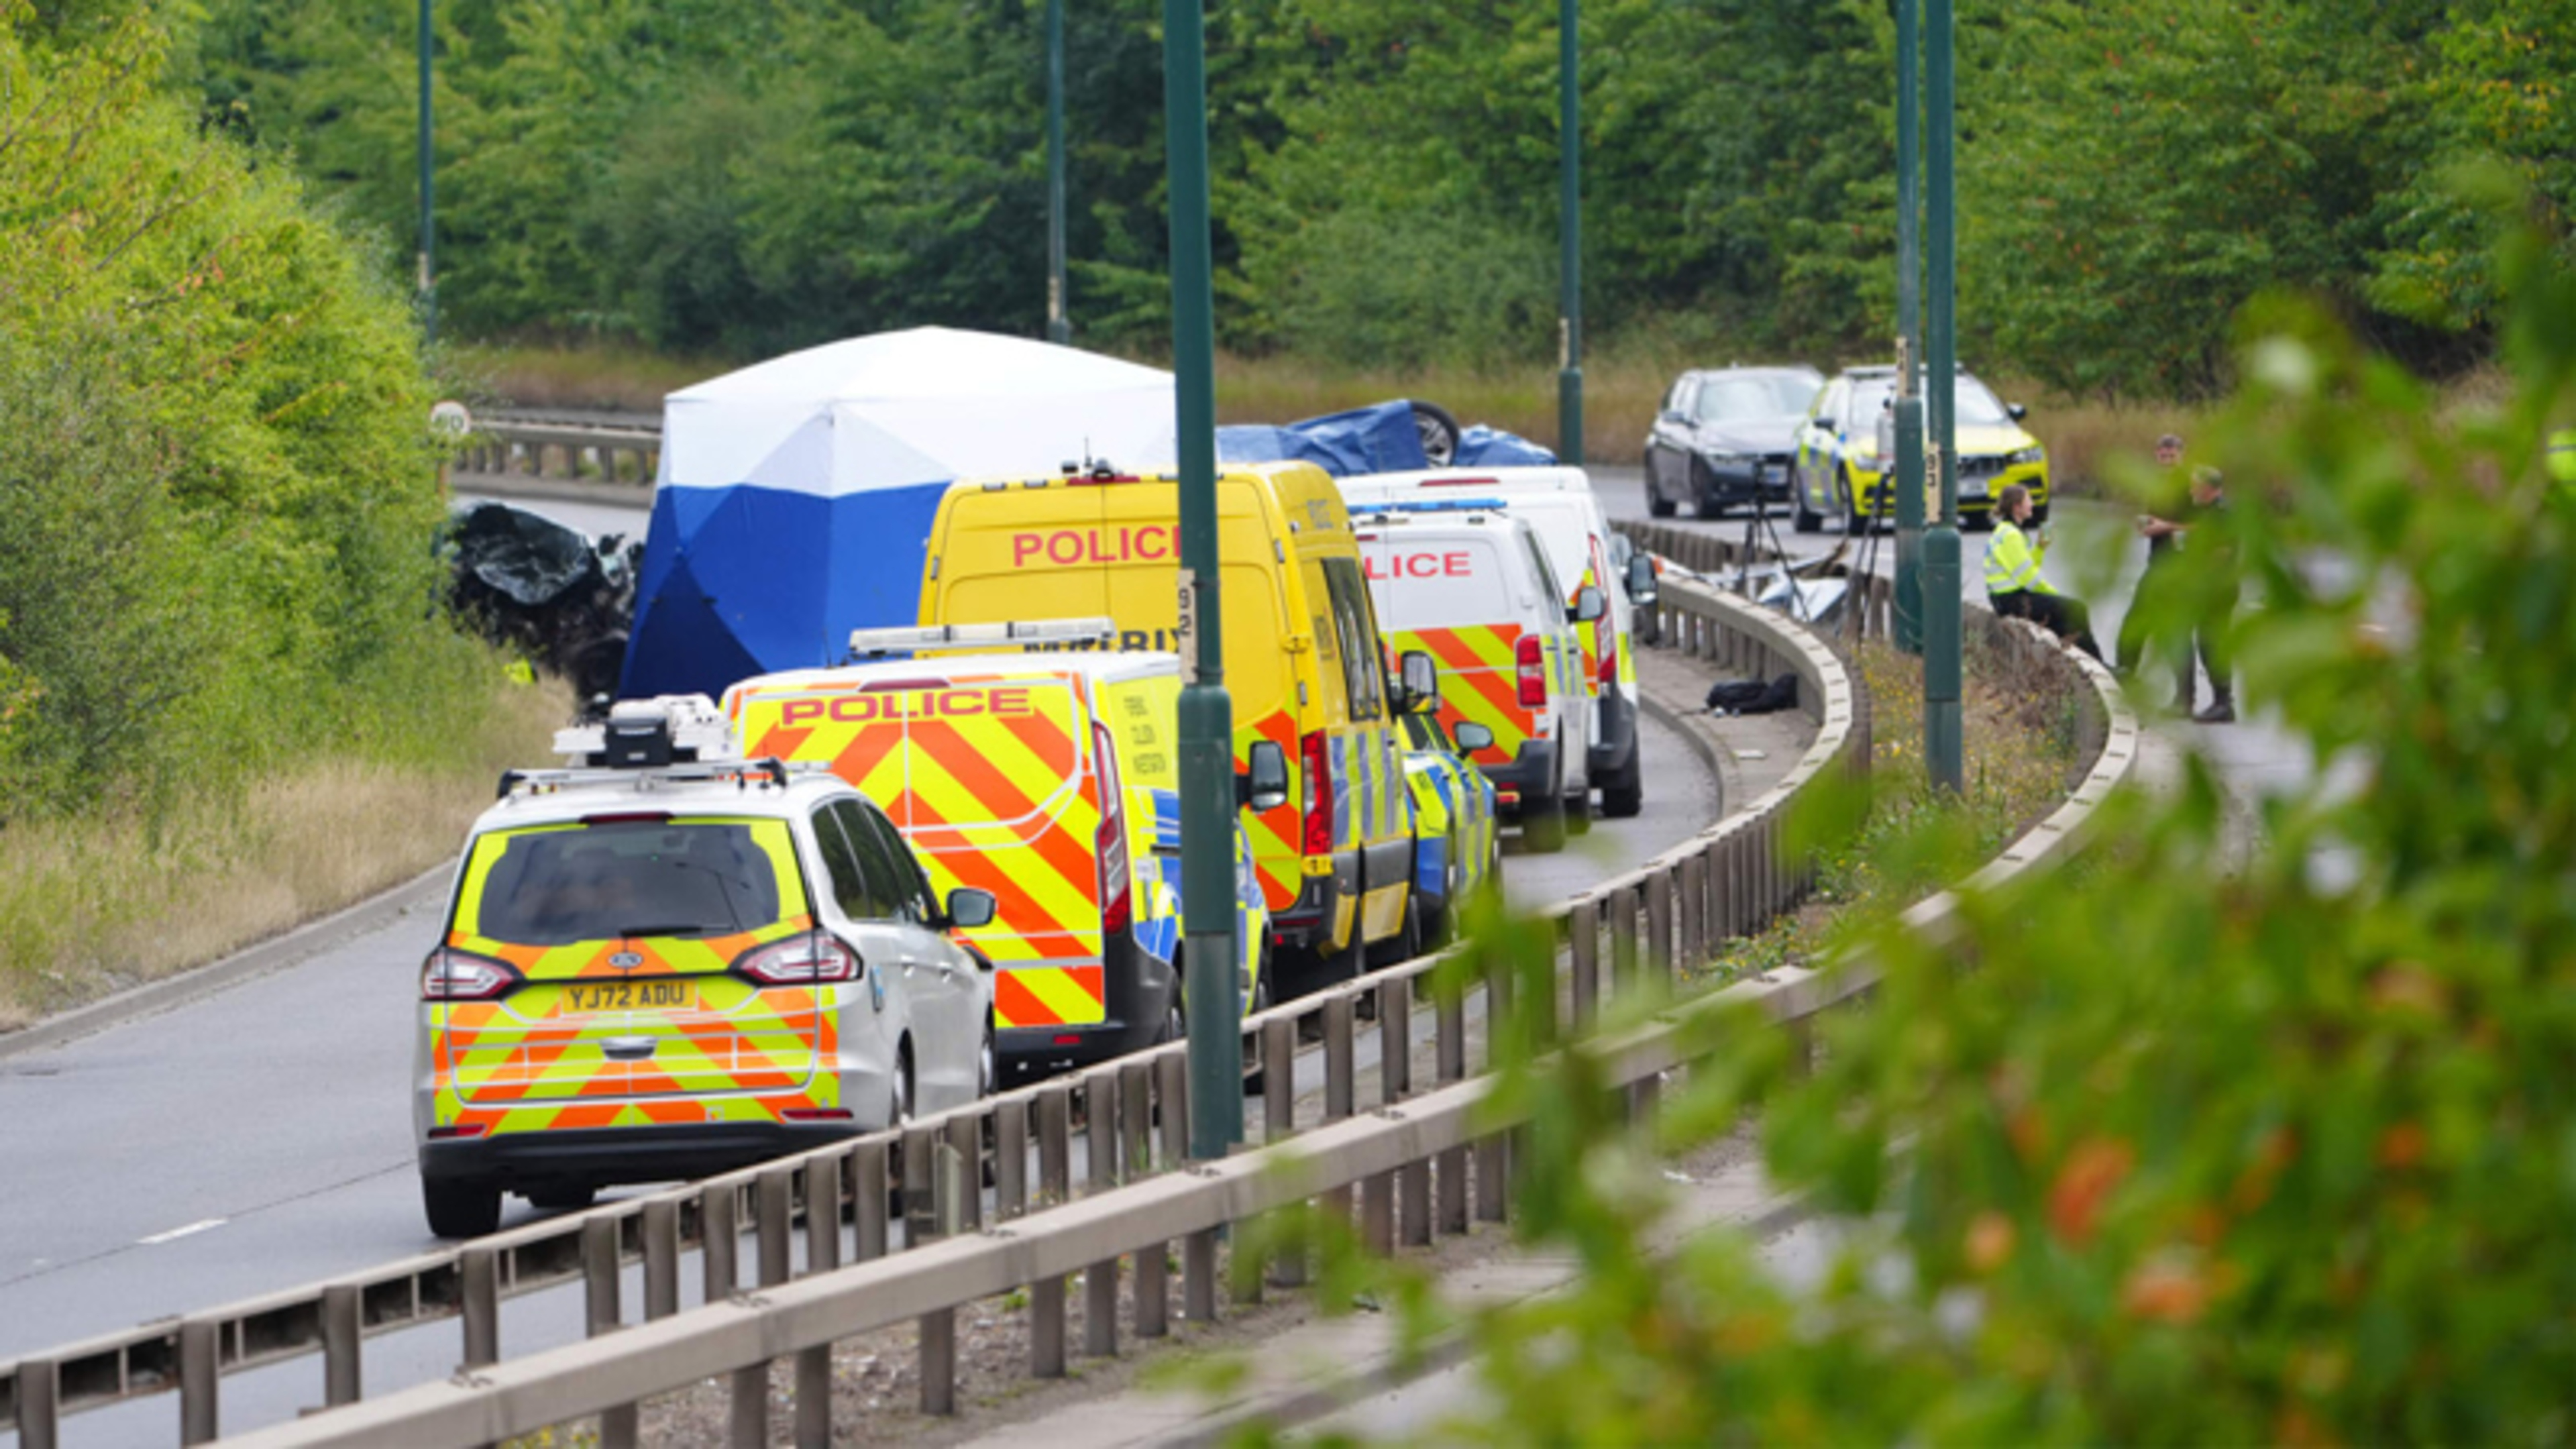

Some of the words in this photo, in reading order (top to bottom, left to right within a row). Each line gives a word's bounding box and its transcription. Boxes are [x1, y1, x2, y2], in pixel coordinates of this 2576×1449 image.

[1364, 550, 1472, 580] LICE
[782, 688, 1030, 726] POLICE
[570, 985, 631, 1009] YJ72
[640, 982, 684, 1006] ADU
